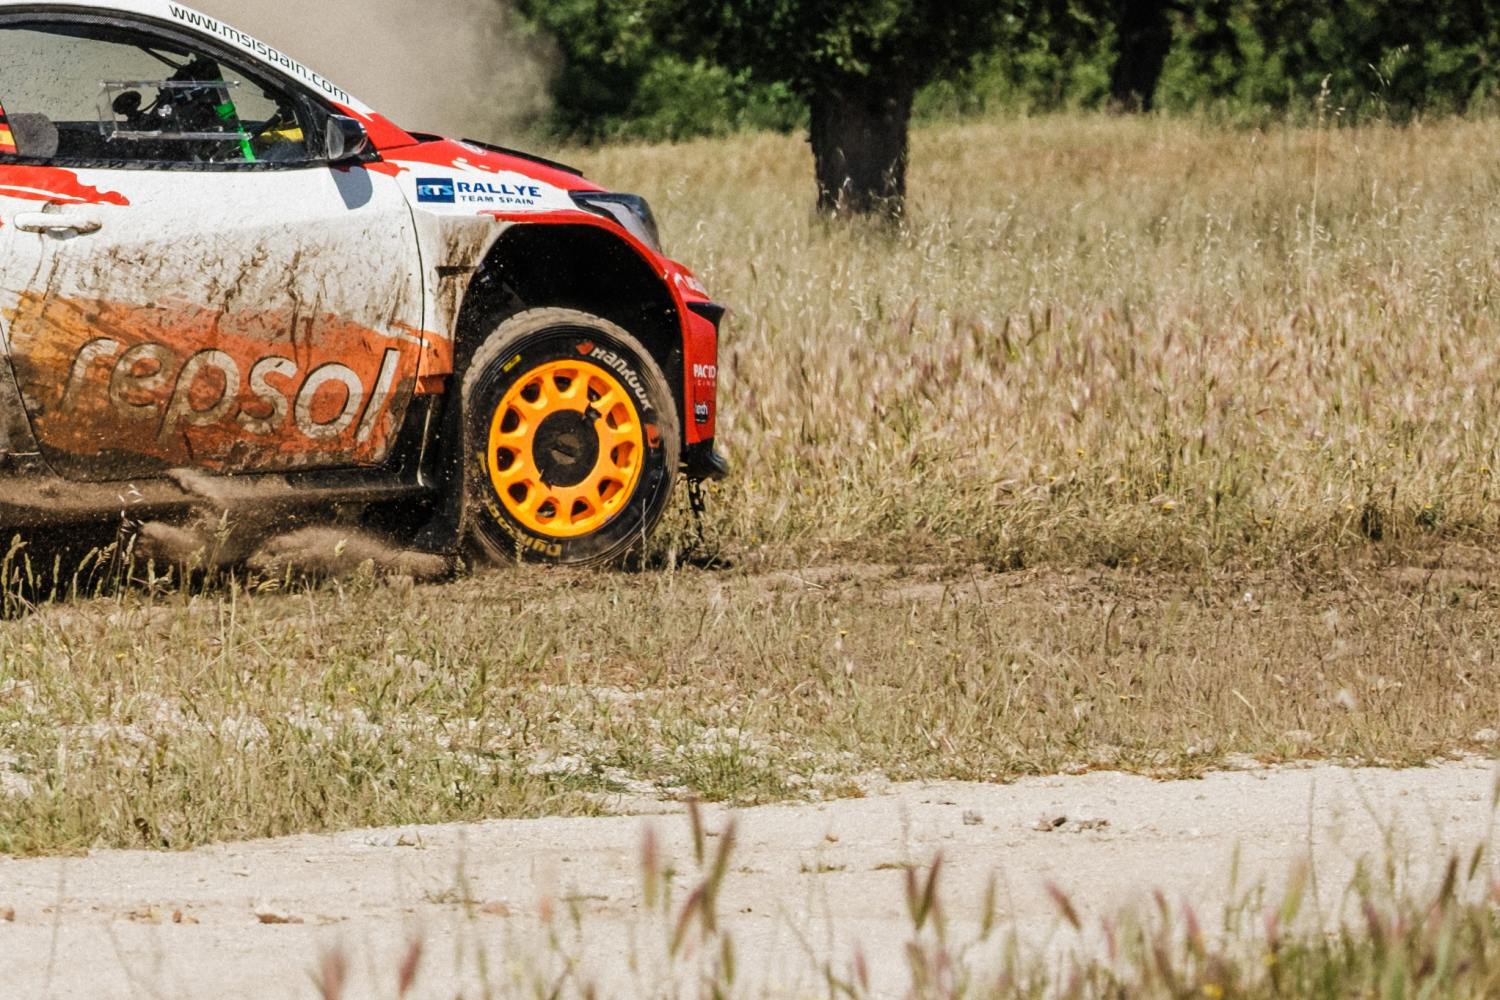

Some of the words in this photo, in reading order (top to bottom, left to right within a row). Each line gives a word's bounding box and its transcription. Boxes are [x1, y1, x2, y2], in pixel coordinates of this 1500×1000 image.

[169, 4, 350, 105] www.msispain.com
[418, 184, 454, 197] RTS
[457, 182, 542, 198] RALLYE
[460, 195, 494, 203] TEAM
[499, 195, 534, 205] SPAIN
[59, 336, 400, 444] repsol
